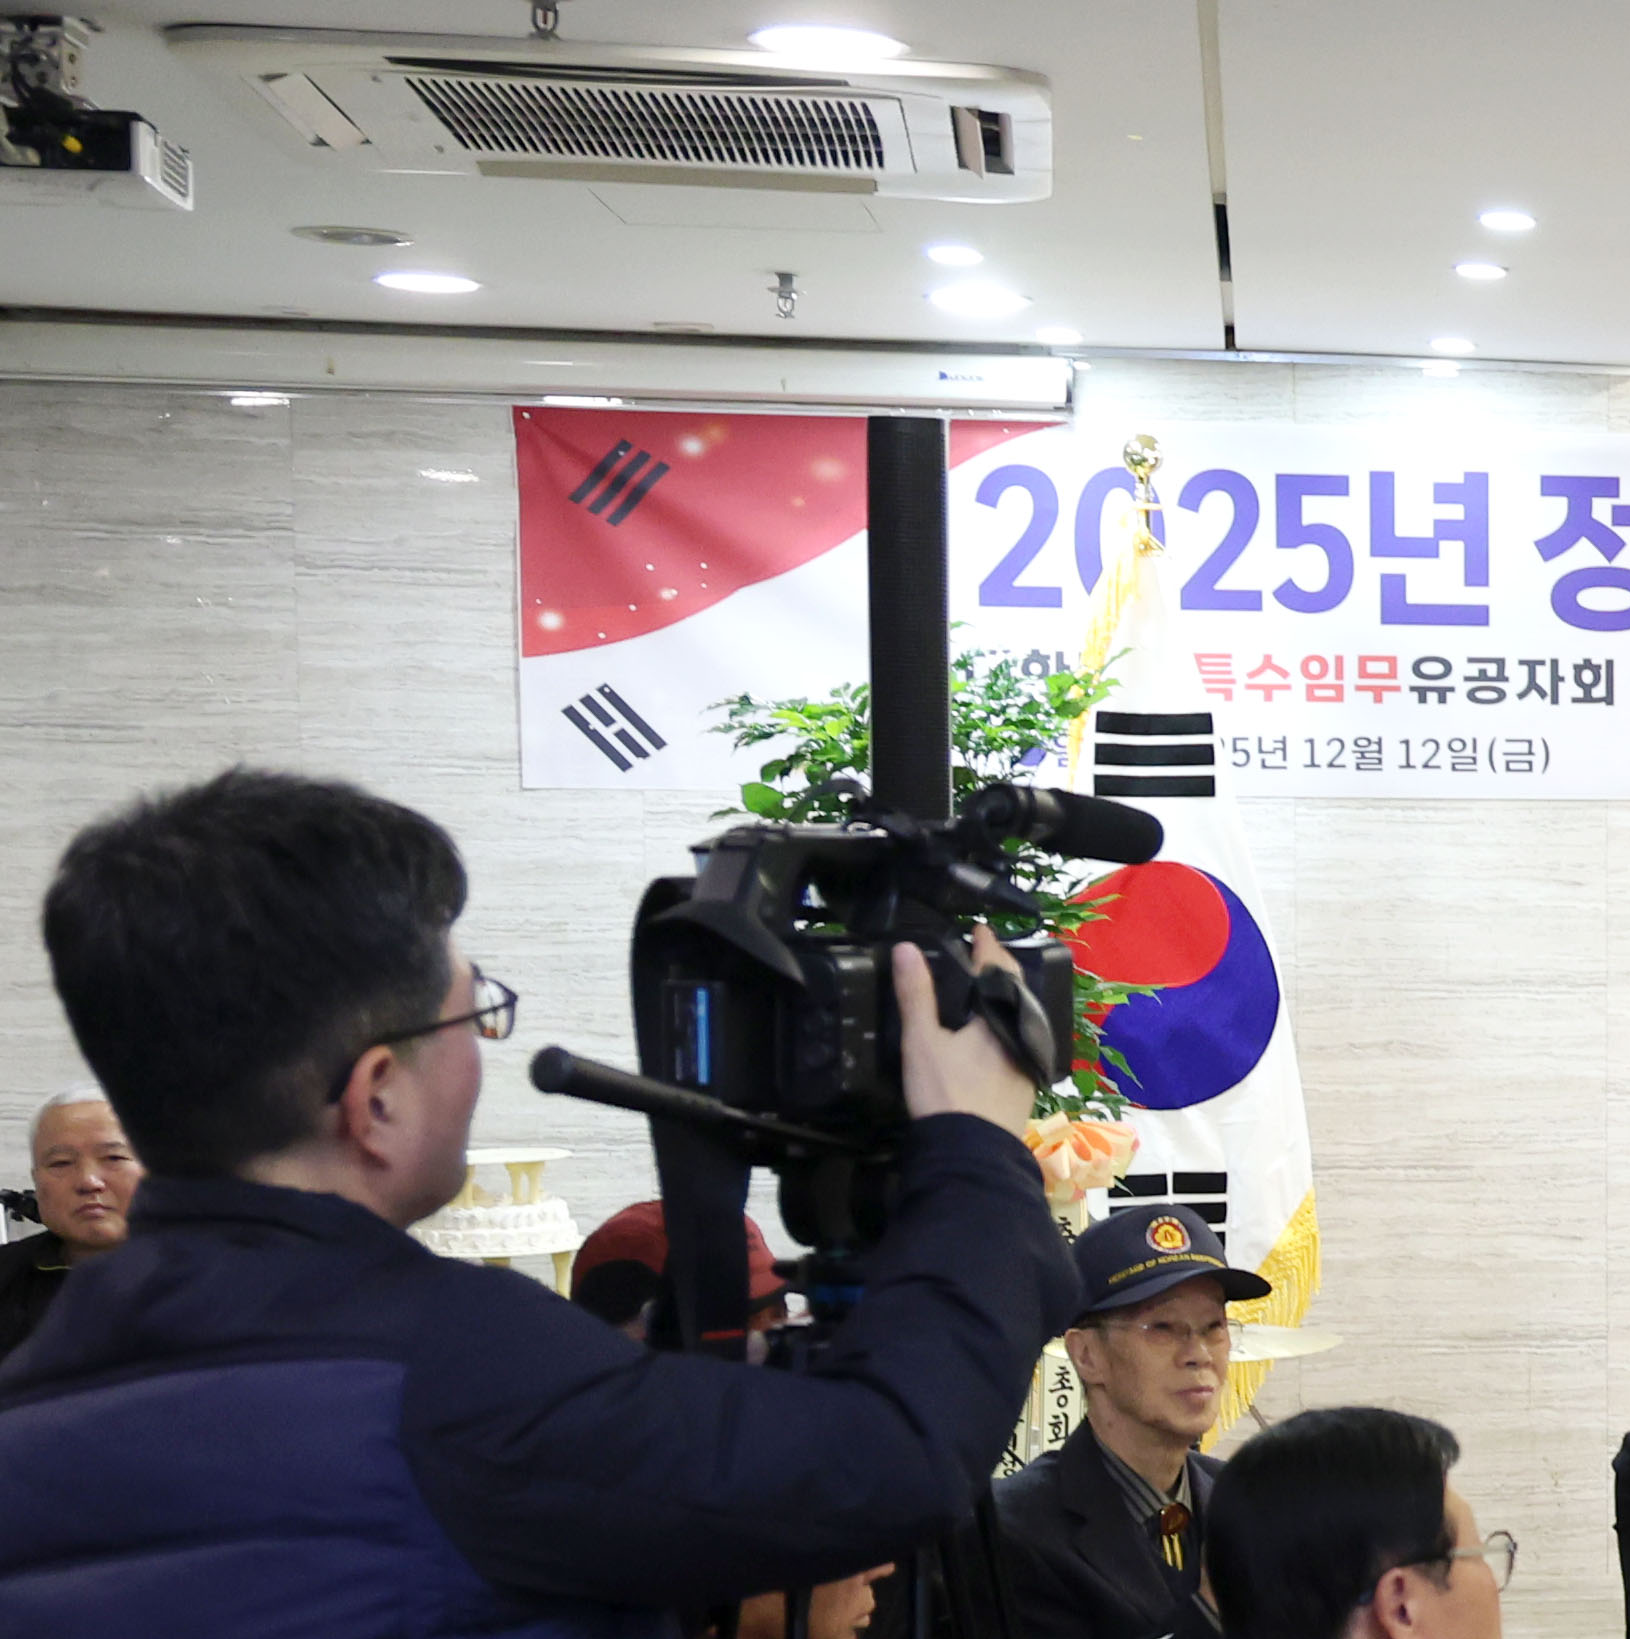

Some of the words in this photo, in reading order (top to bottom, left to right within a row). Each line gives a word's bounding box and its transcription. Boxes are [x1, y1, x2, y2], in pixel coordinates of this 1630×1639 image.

[975, 464, 1490, 627] 2025년
[1193, 652, 1615, 707] 특수임무유공자회
[1302, 735, 1384, 772] 12월
[1397, 736, 1551, 775] 12일(금)
